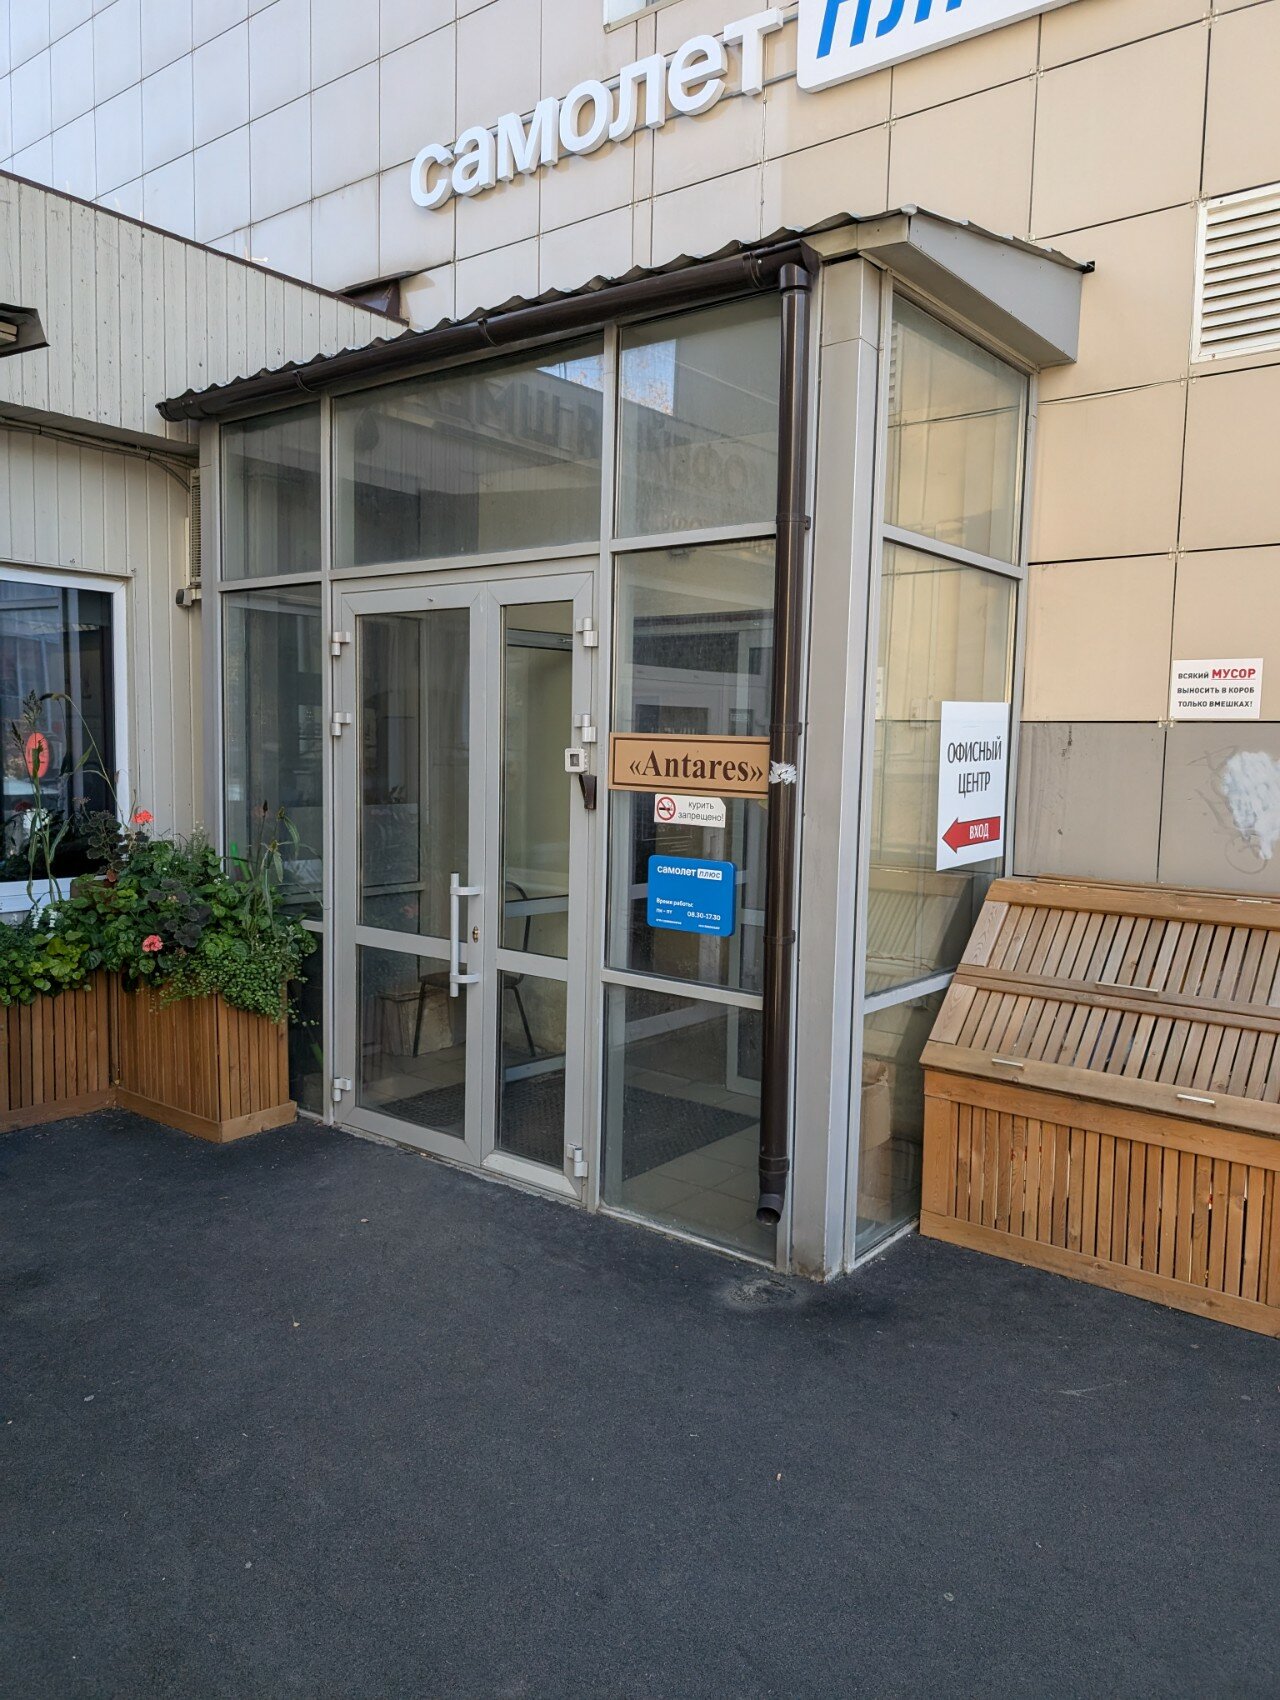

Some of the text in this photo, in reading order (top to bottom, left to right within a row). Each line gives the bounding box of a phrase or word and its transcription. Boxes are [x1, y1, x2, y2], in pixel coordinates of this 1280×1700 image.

[410, 7, 784, 210] самолет
[1178, 668, 1256, 680] ВСЯКИЙ МУСОР
[947, 735, 1002, 764] ОФИСНЫЙ
[629, 750, 764, 782] «Antares»
[958, 771, 991, 798] ЦЕНТР
[688, 801, 715, 810] курить
[678, 811, 724, 822] запрещено!
[969, 823, 989, 840] ВХОД
[657, 866, 696, 876] самолет
